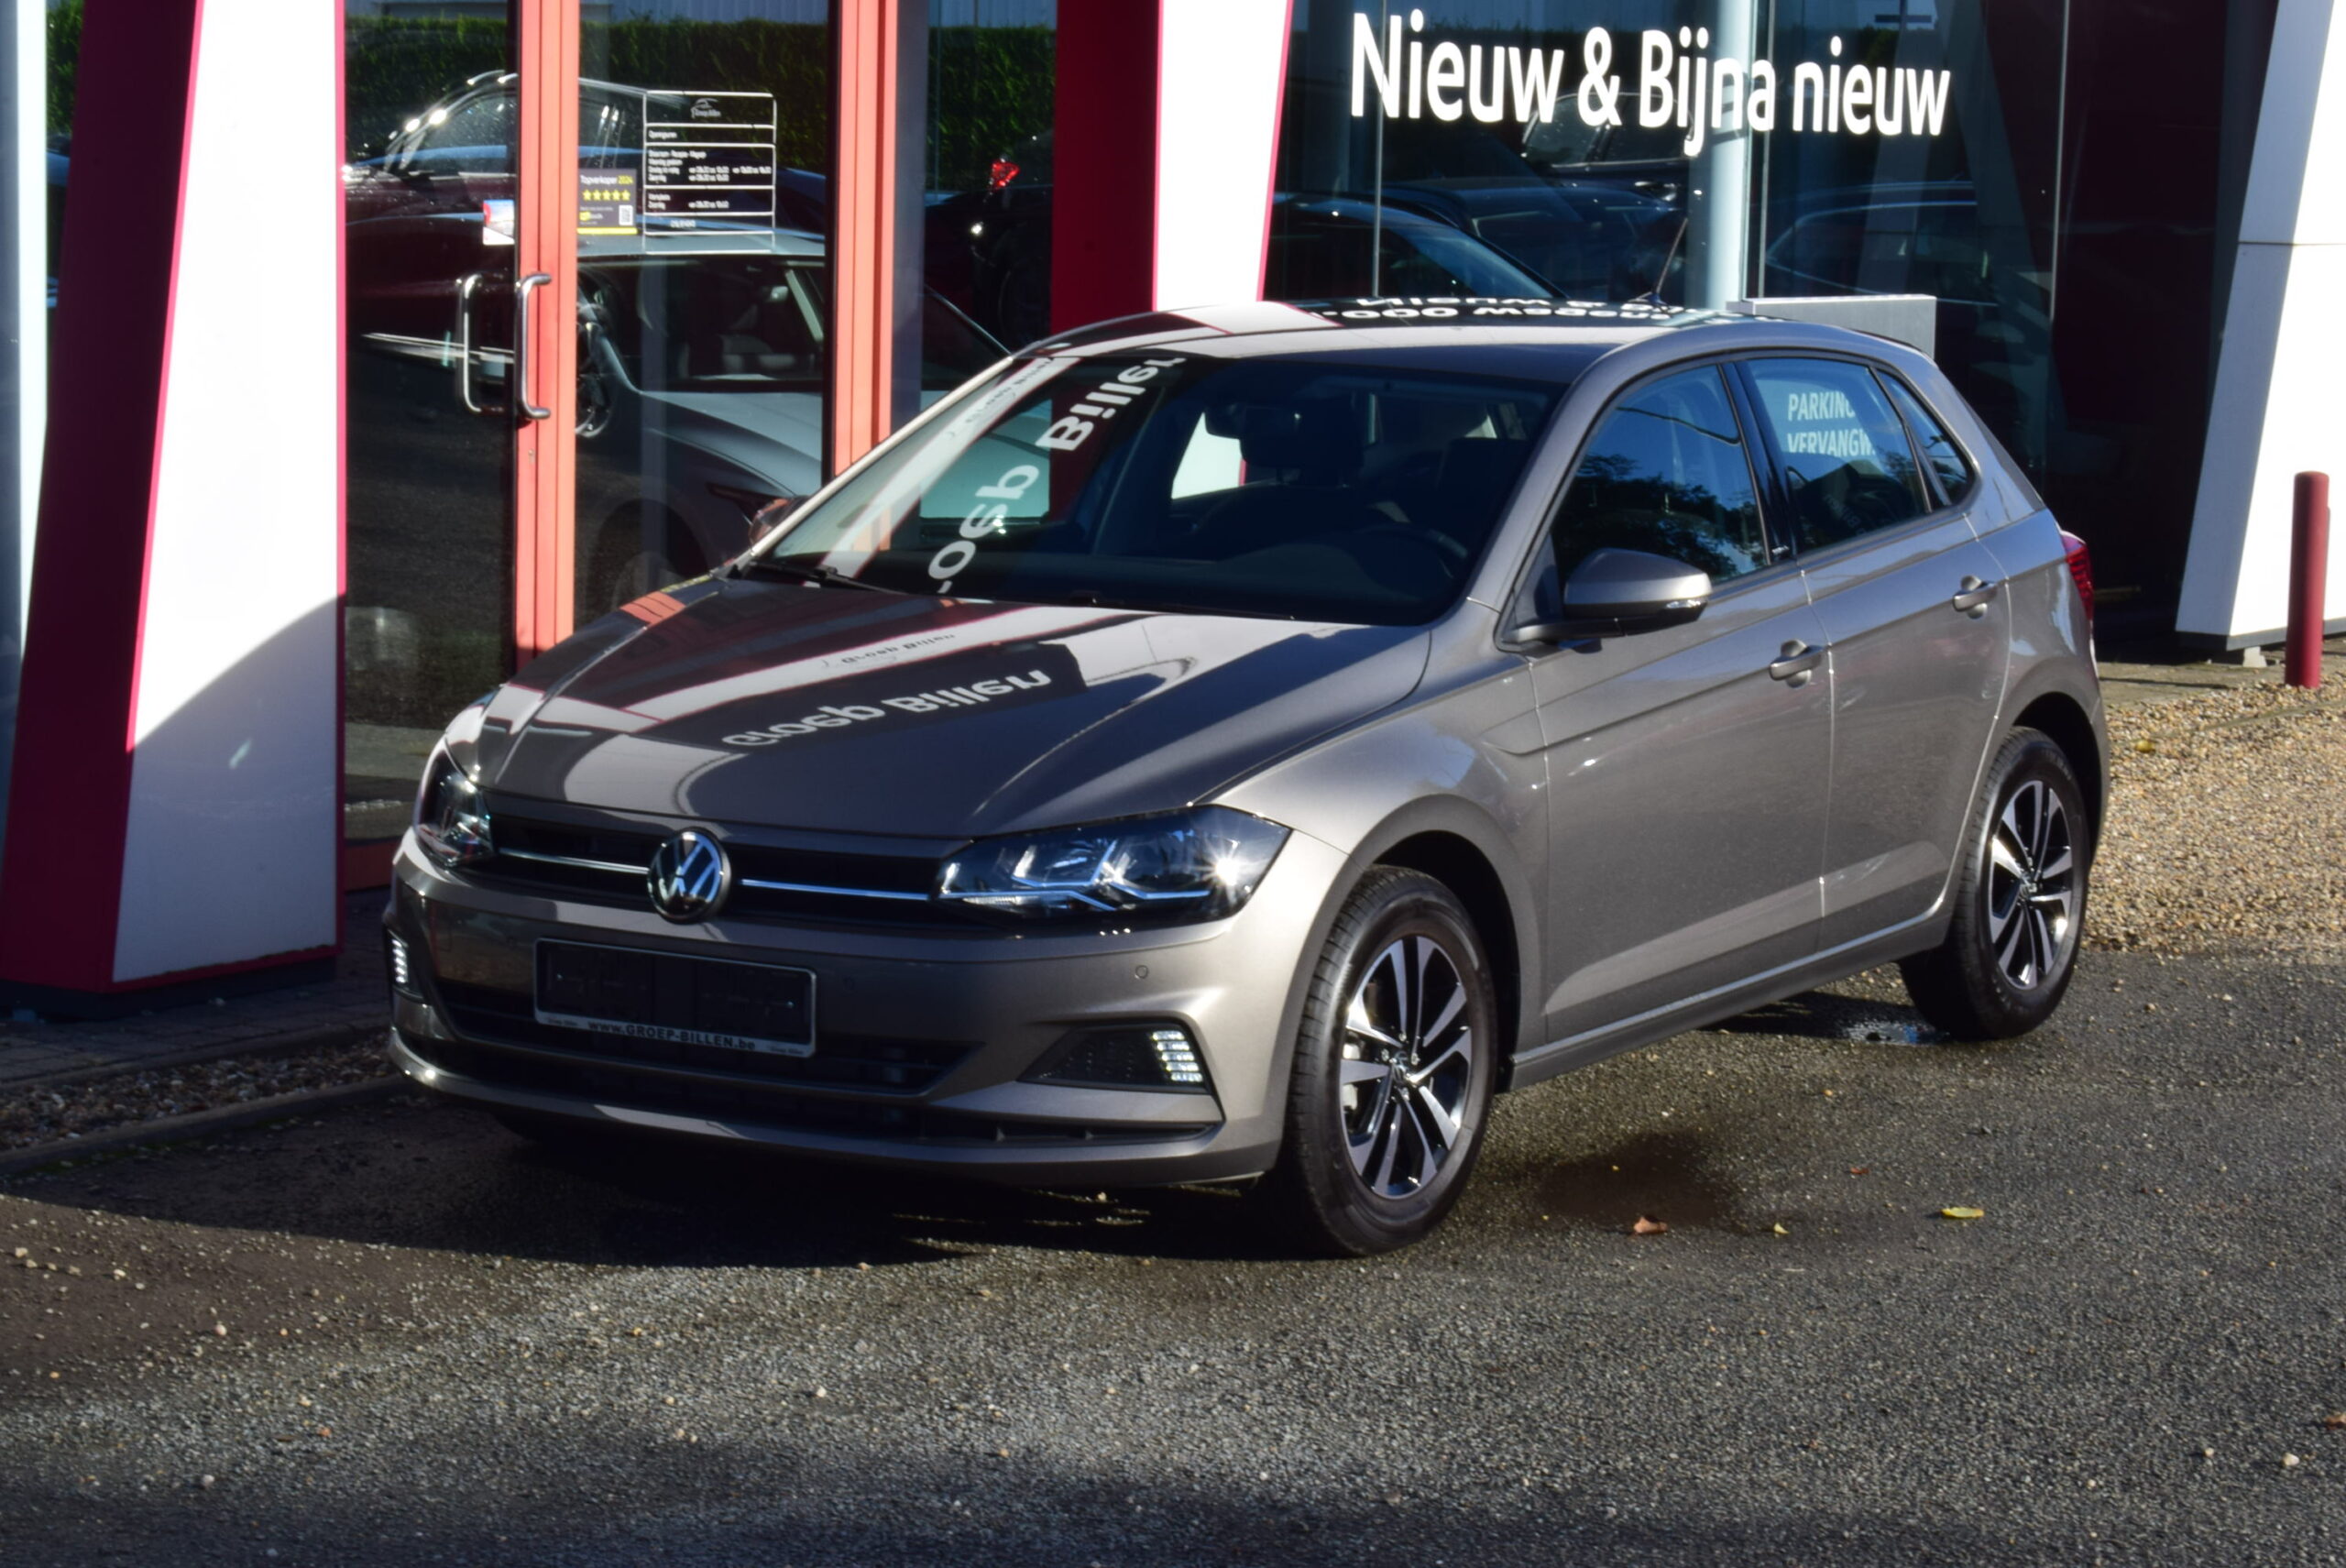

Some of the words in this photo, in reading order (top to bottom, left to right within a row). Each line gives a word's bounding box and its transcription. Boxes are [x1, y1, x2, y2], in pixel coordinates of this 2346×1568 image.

[1351, 8, 1564, 124] Nieuw
[1577, 26, 1622, 127] &
[1639, 26, 1776, 157] Bijna
[1792, 36, 1951, 137] nieuw
[587, 1019, 756, 1051] www.GROEP-BILLEN.be
